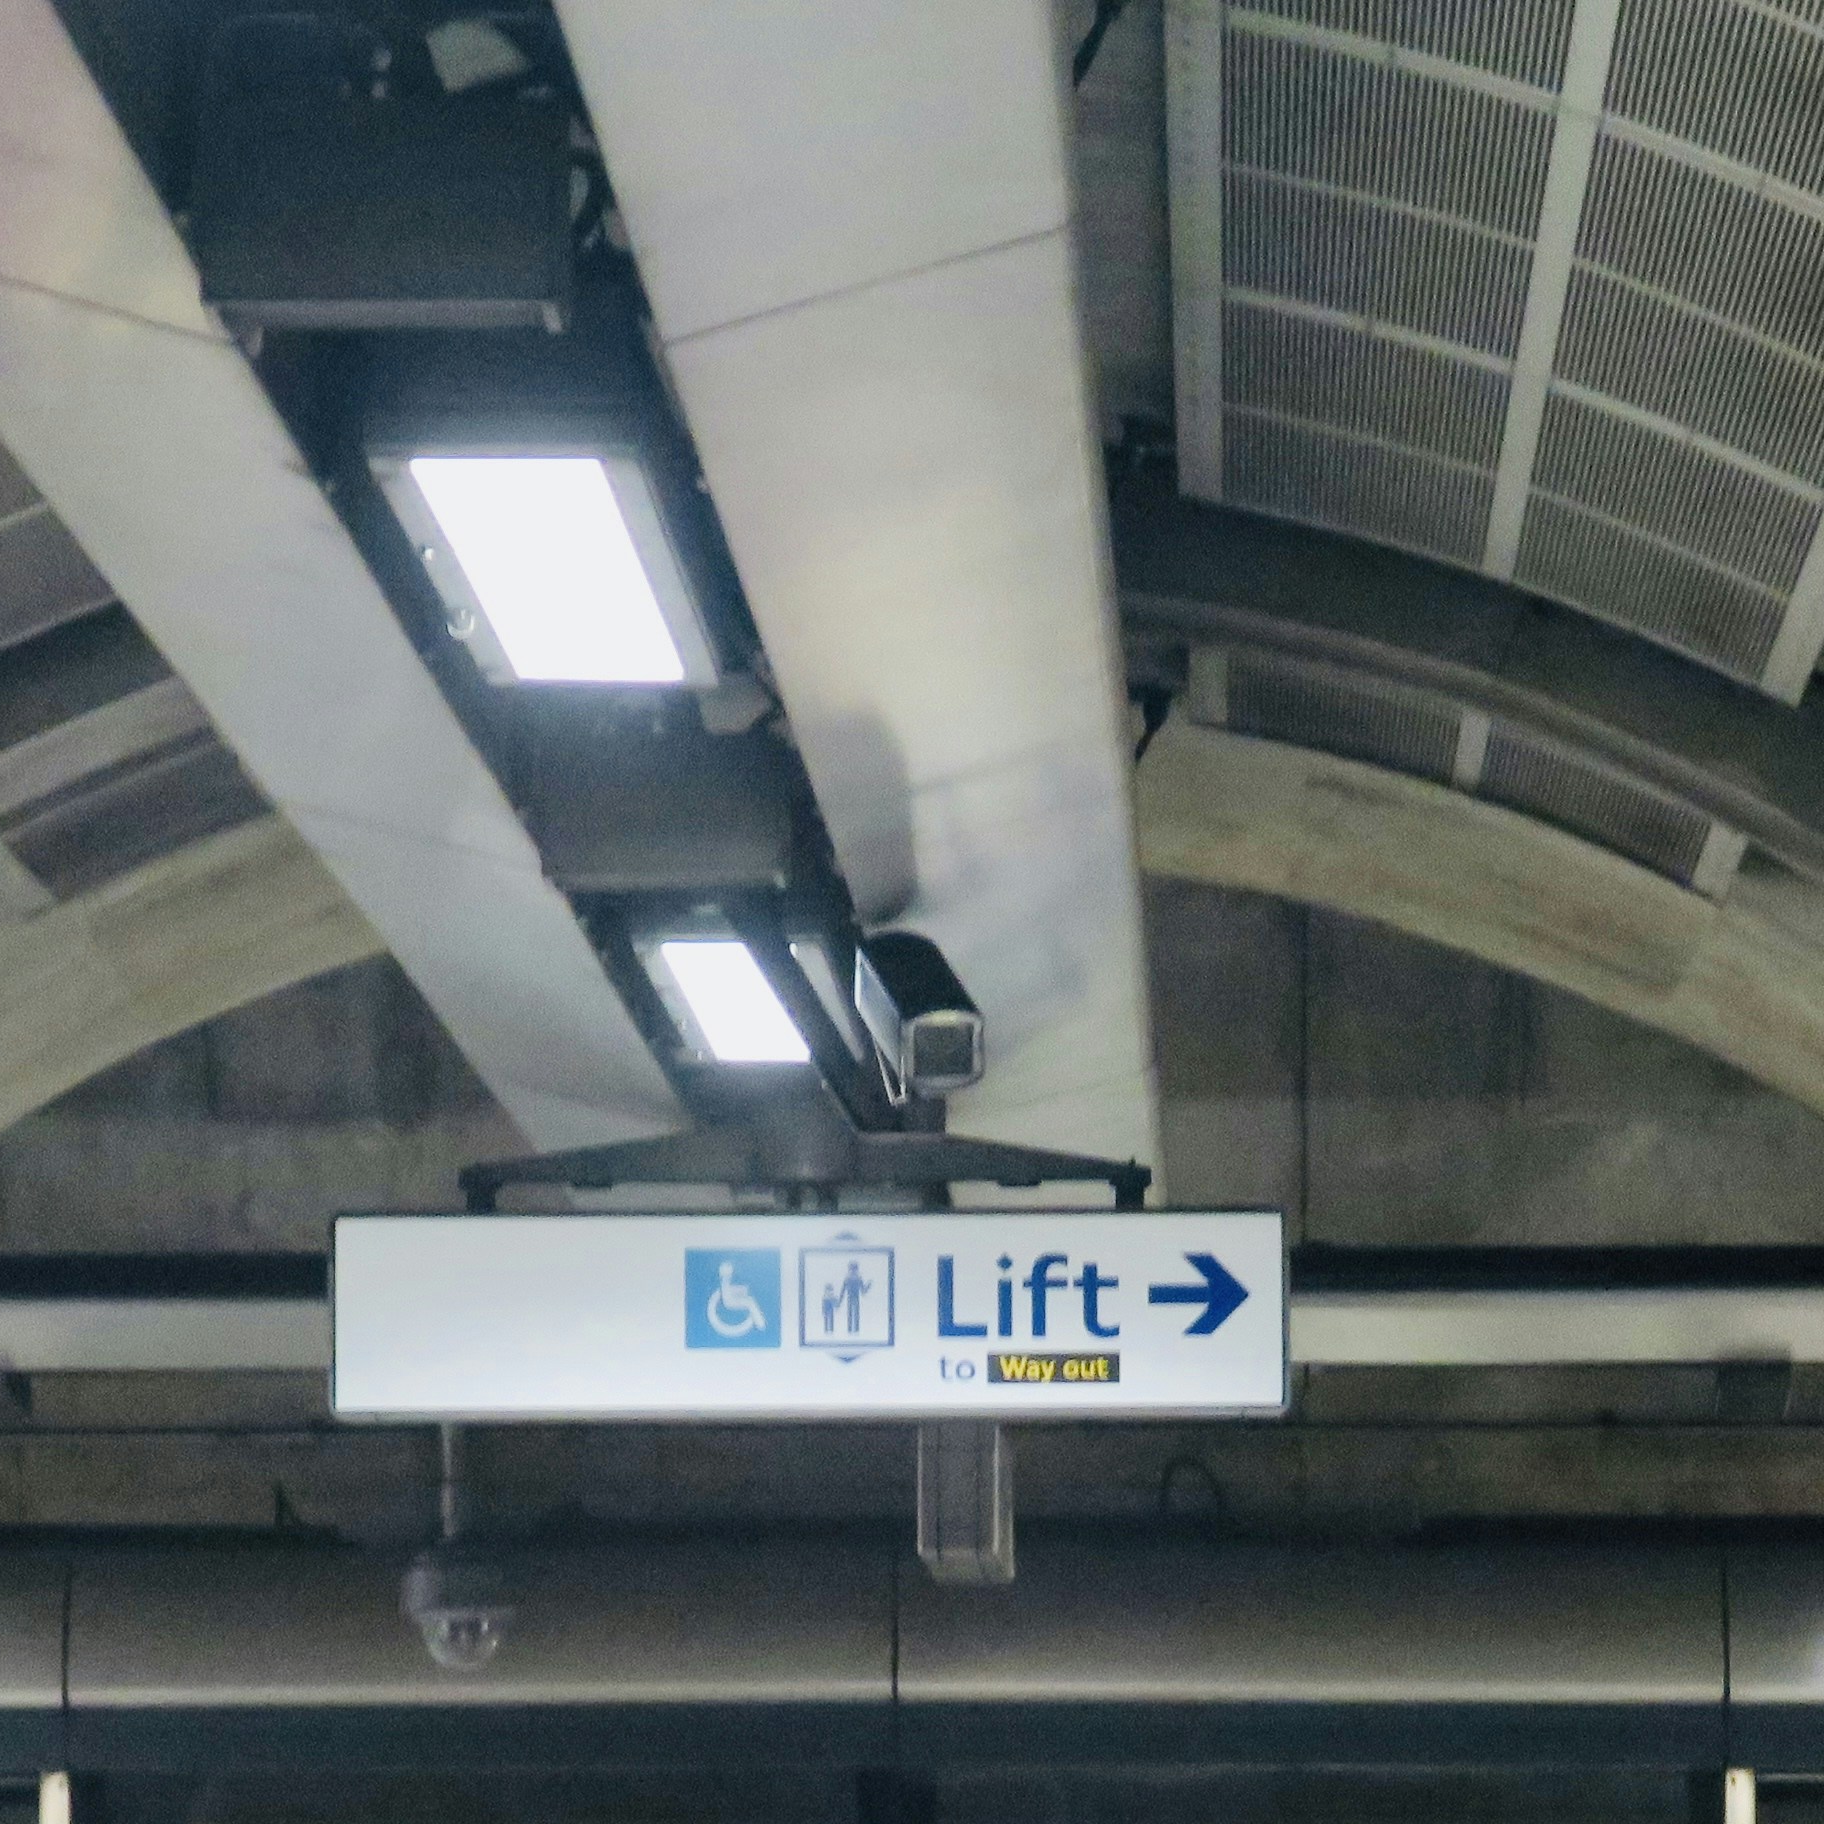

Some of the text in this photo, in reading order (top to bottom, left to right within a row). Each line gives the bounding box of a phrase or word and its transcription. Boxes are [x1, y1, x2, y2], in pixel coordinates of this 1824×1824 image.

[936, 1252, 1120, 1338] Lift
[939, 1354, 1110, 1383] to Way out
